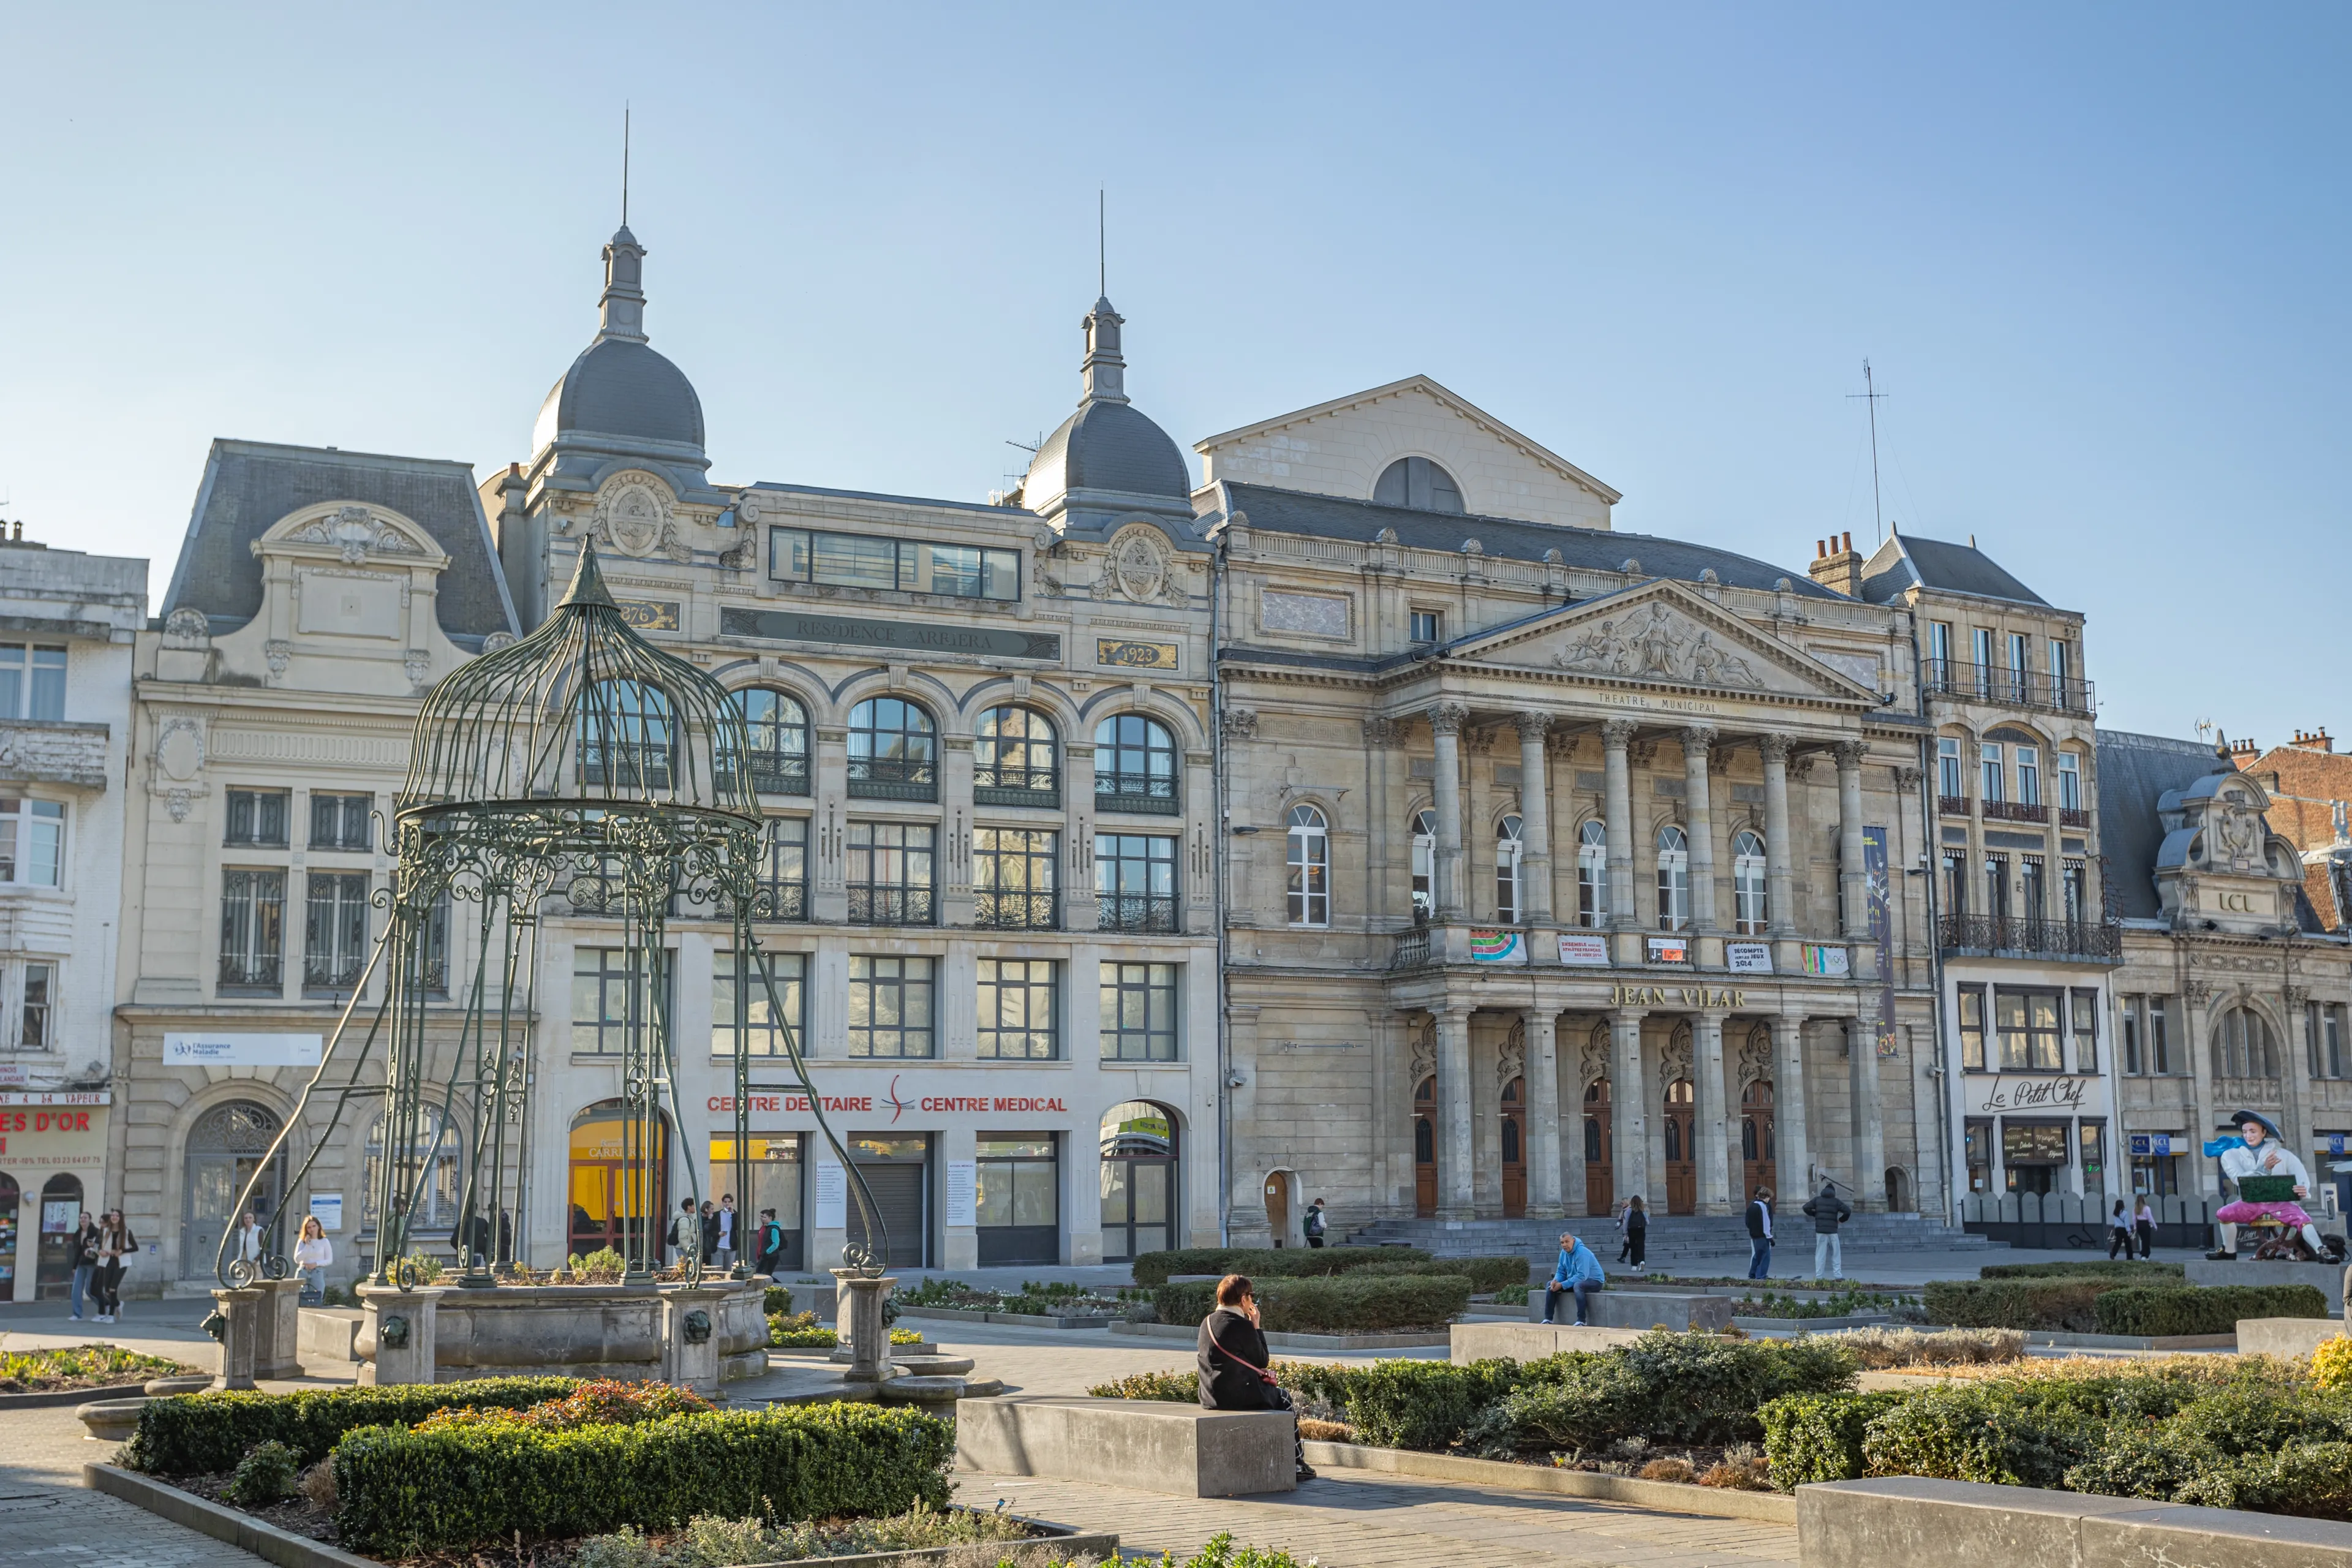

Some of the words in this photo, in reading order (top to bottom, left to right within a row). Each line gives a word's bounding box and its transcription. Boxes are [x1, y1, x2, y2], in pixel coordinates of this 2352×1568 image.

[620, 606, 649, 624] 876
[796, 620, 896, 641] RESIDENCE
[905, 628, 993, 649] CARRIERA
[1121, 647, 1153, 662] 1923
[1599, 693, 1646, 706] THEATRE
[1662, 699, 1716, 713] MUNICIPAL
[2218, 892, 2256, 913] LCL
[1610, 987, 1665, 1005] JEAN
[1680, 989, 1745, 1007] VILAR
[66, 1094, 100, 1103] VAPEUR
[1982, 1075, 2006, 1110] Le
[2015, 1081, 2052, 1106] Petit
[2052, 1075, 2086, 1110] Chef
[707, 1096, 780, 1112] CETRE
[921, 1098, 989, 1112] CENTRE
[994, 1098, 1068, 1112] MEDICAL
[36, 1112, 90, 1132] D'OR
[589, 1148, 645, 1157] CARRIRA
